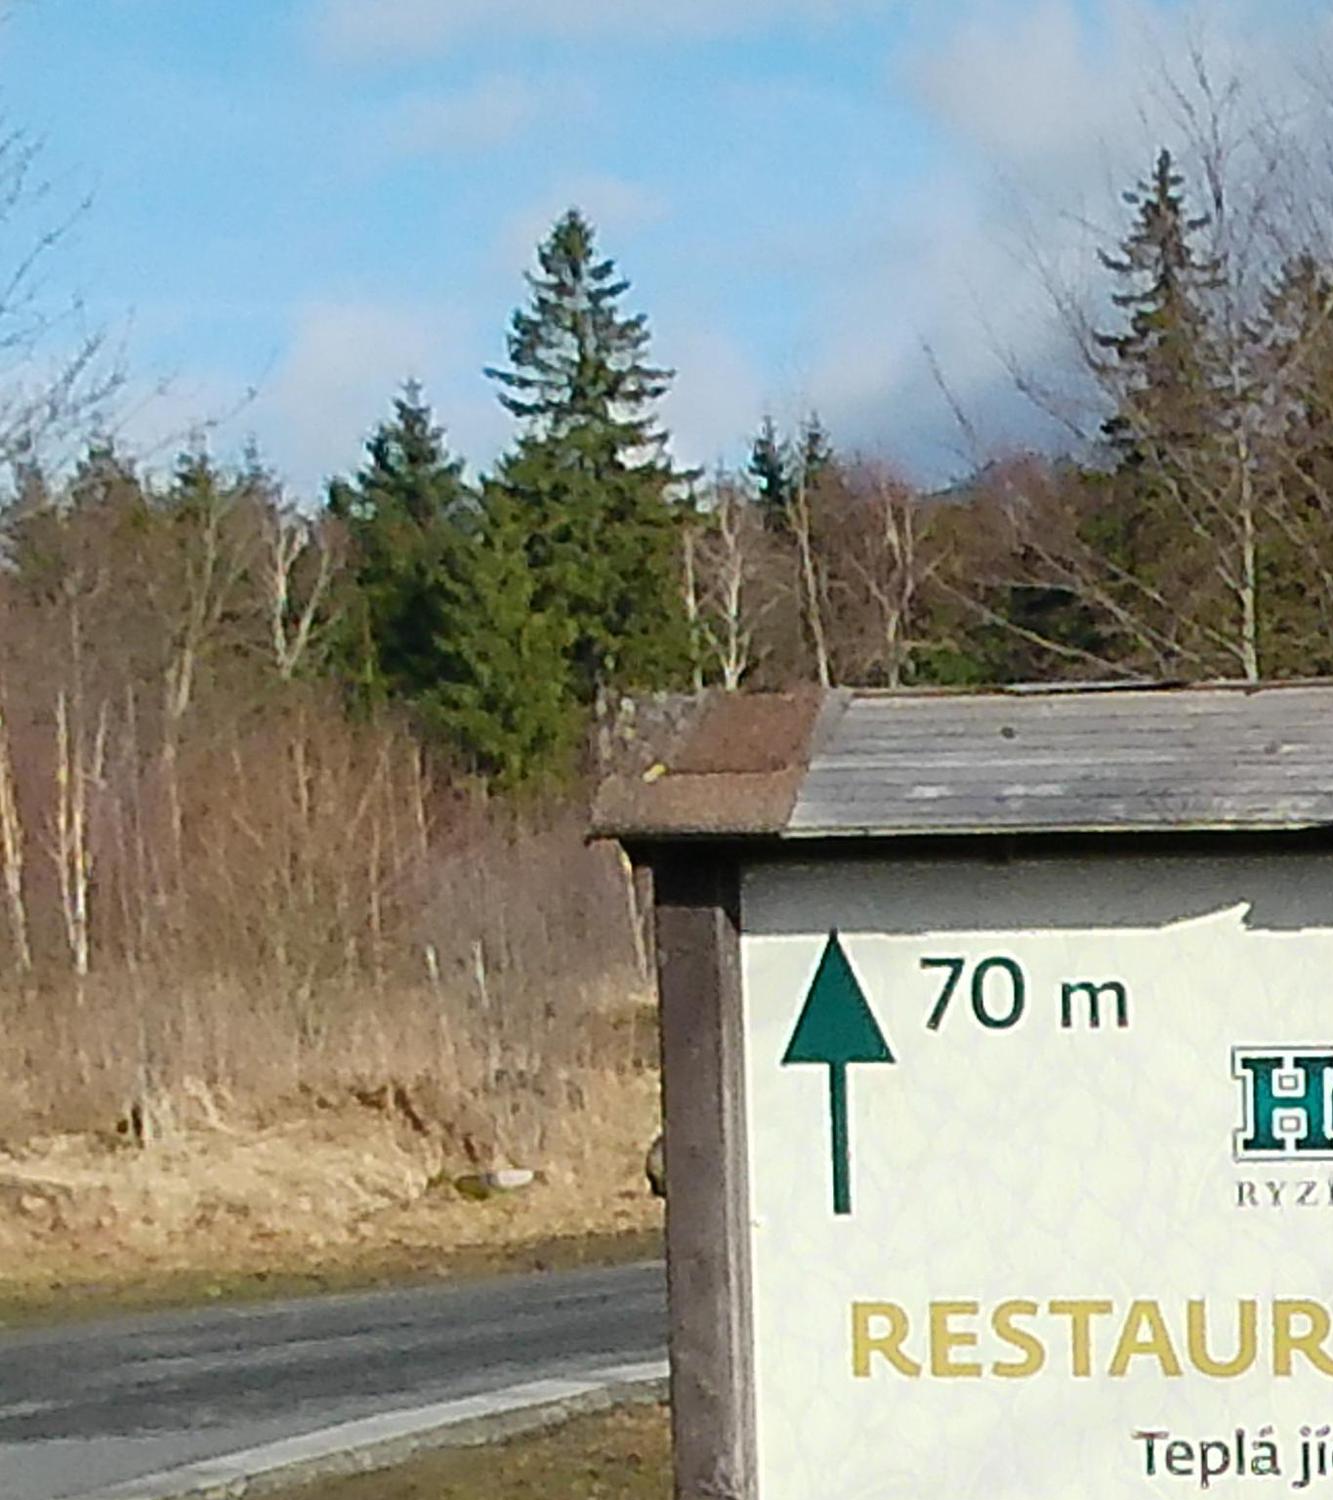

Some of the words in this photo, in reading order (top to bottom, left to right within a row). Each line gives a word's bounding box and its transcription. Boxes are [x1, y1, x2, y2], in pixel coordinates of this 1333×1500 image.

[919, 956, 1026, 1031] 70
[1060, 981, 1128, 1028] m
[1134, 1427, 1282, 1488] Teplá
